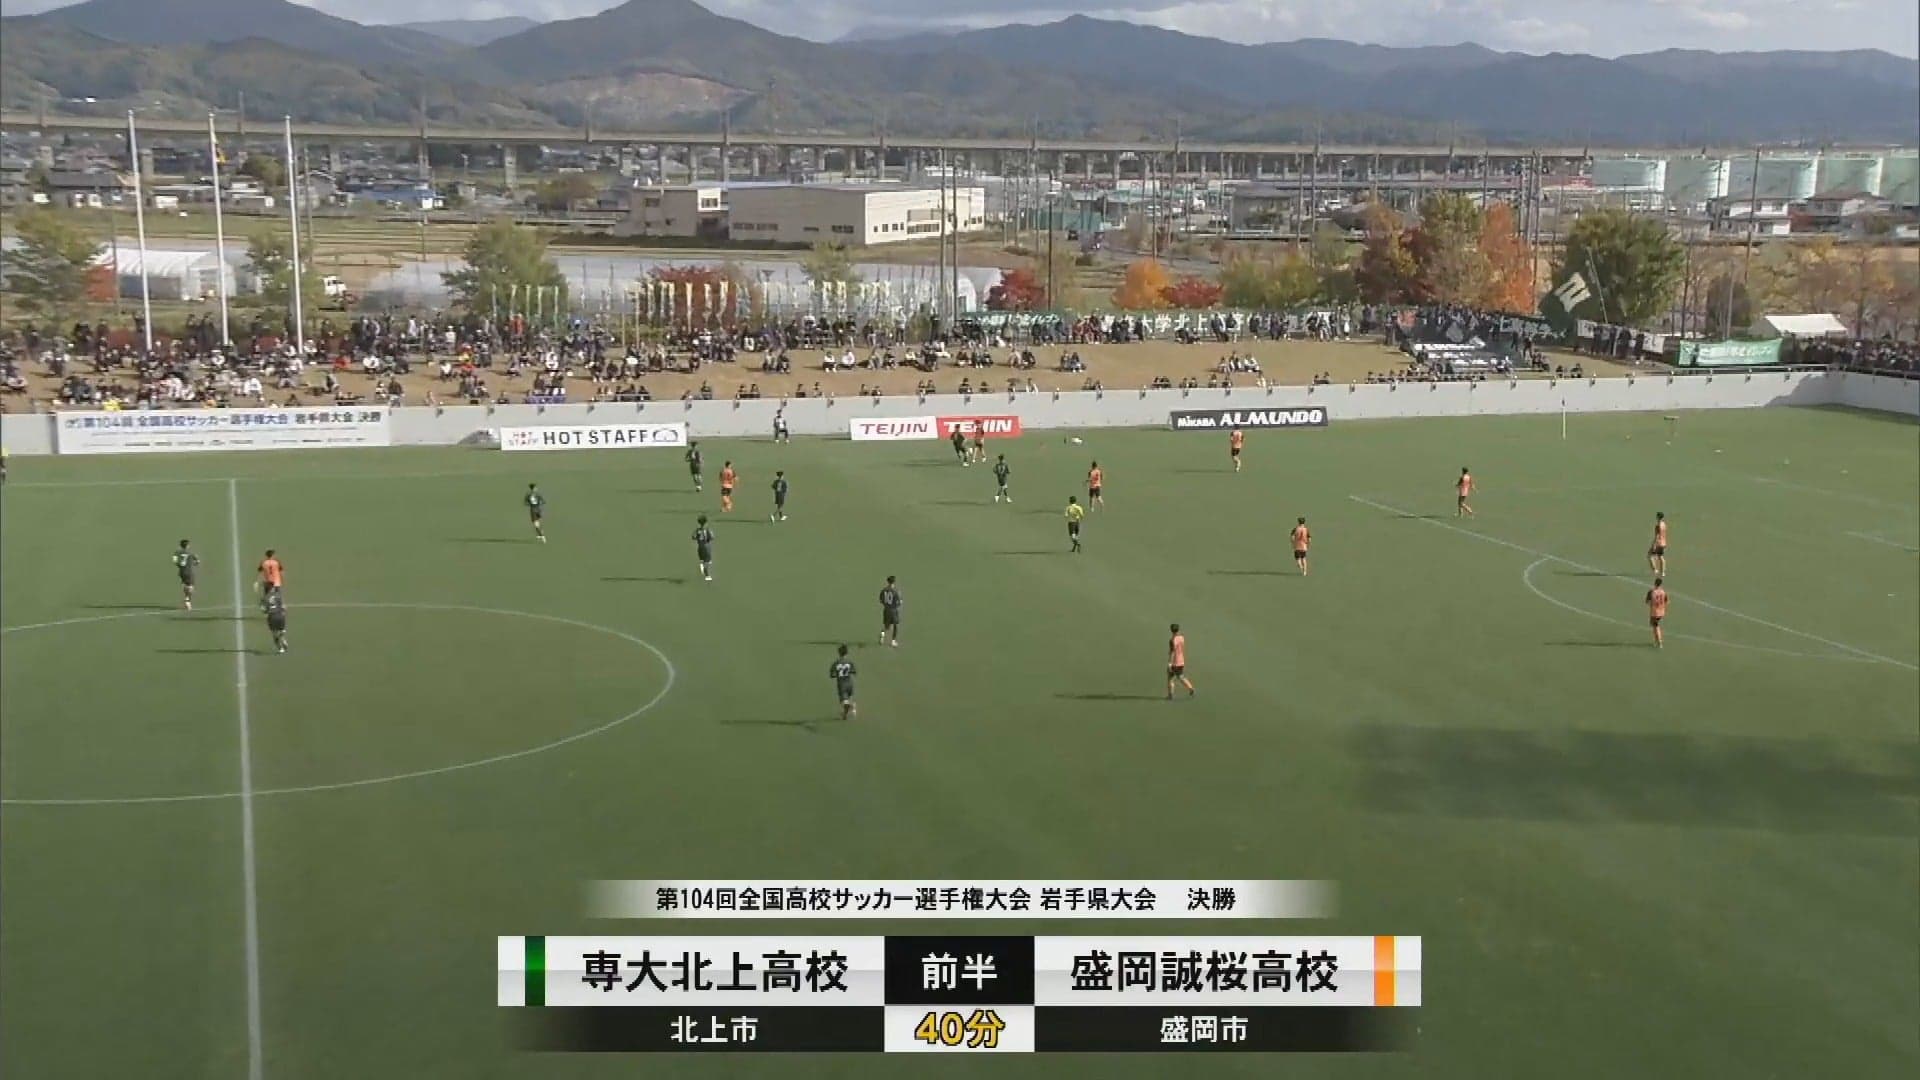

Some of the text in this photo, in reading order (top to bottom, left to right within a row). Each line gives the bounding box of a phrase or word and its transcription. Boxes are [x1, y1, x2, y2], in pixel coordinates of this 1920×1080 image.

[1220, 410, 1322, 426] ALMUNDO
[543, 429, 649, 445] HOT STAFF
[860, 423, 928, 436] TEIJIN
